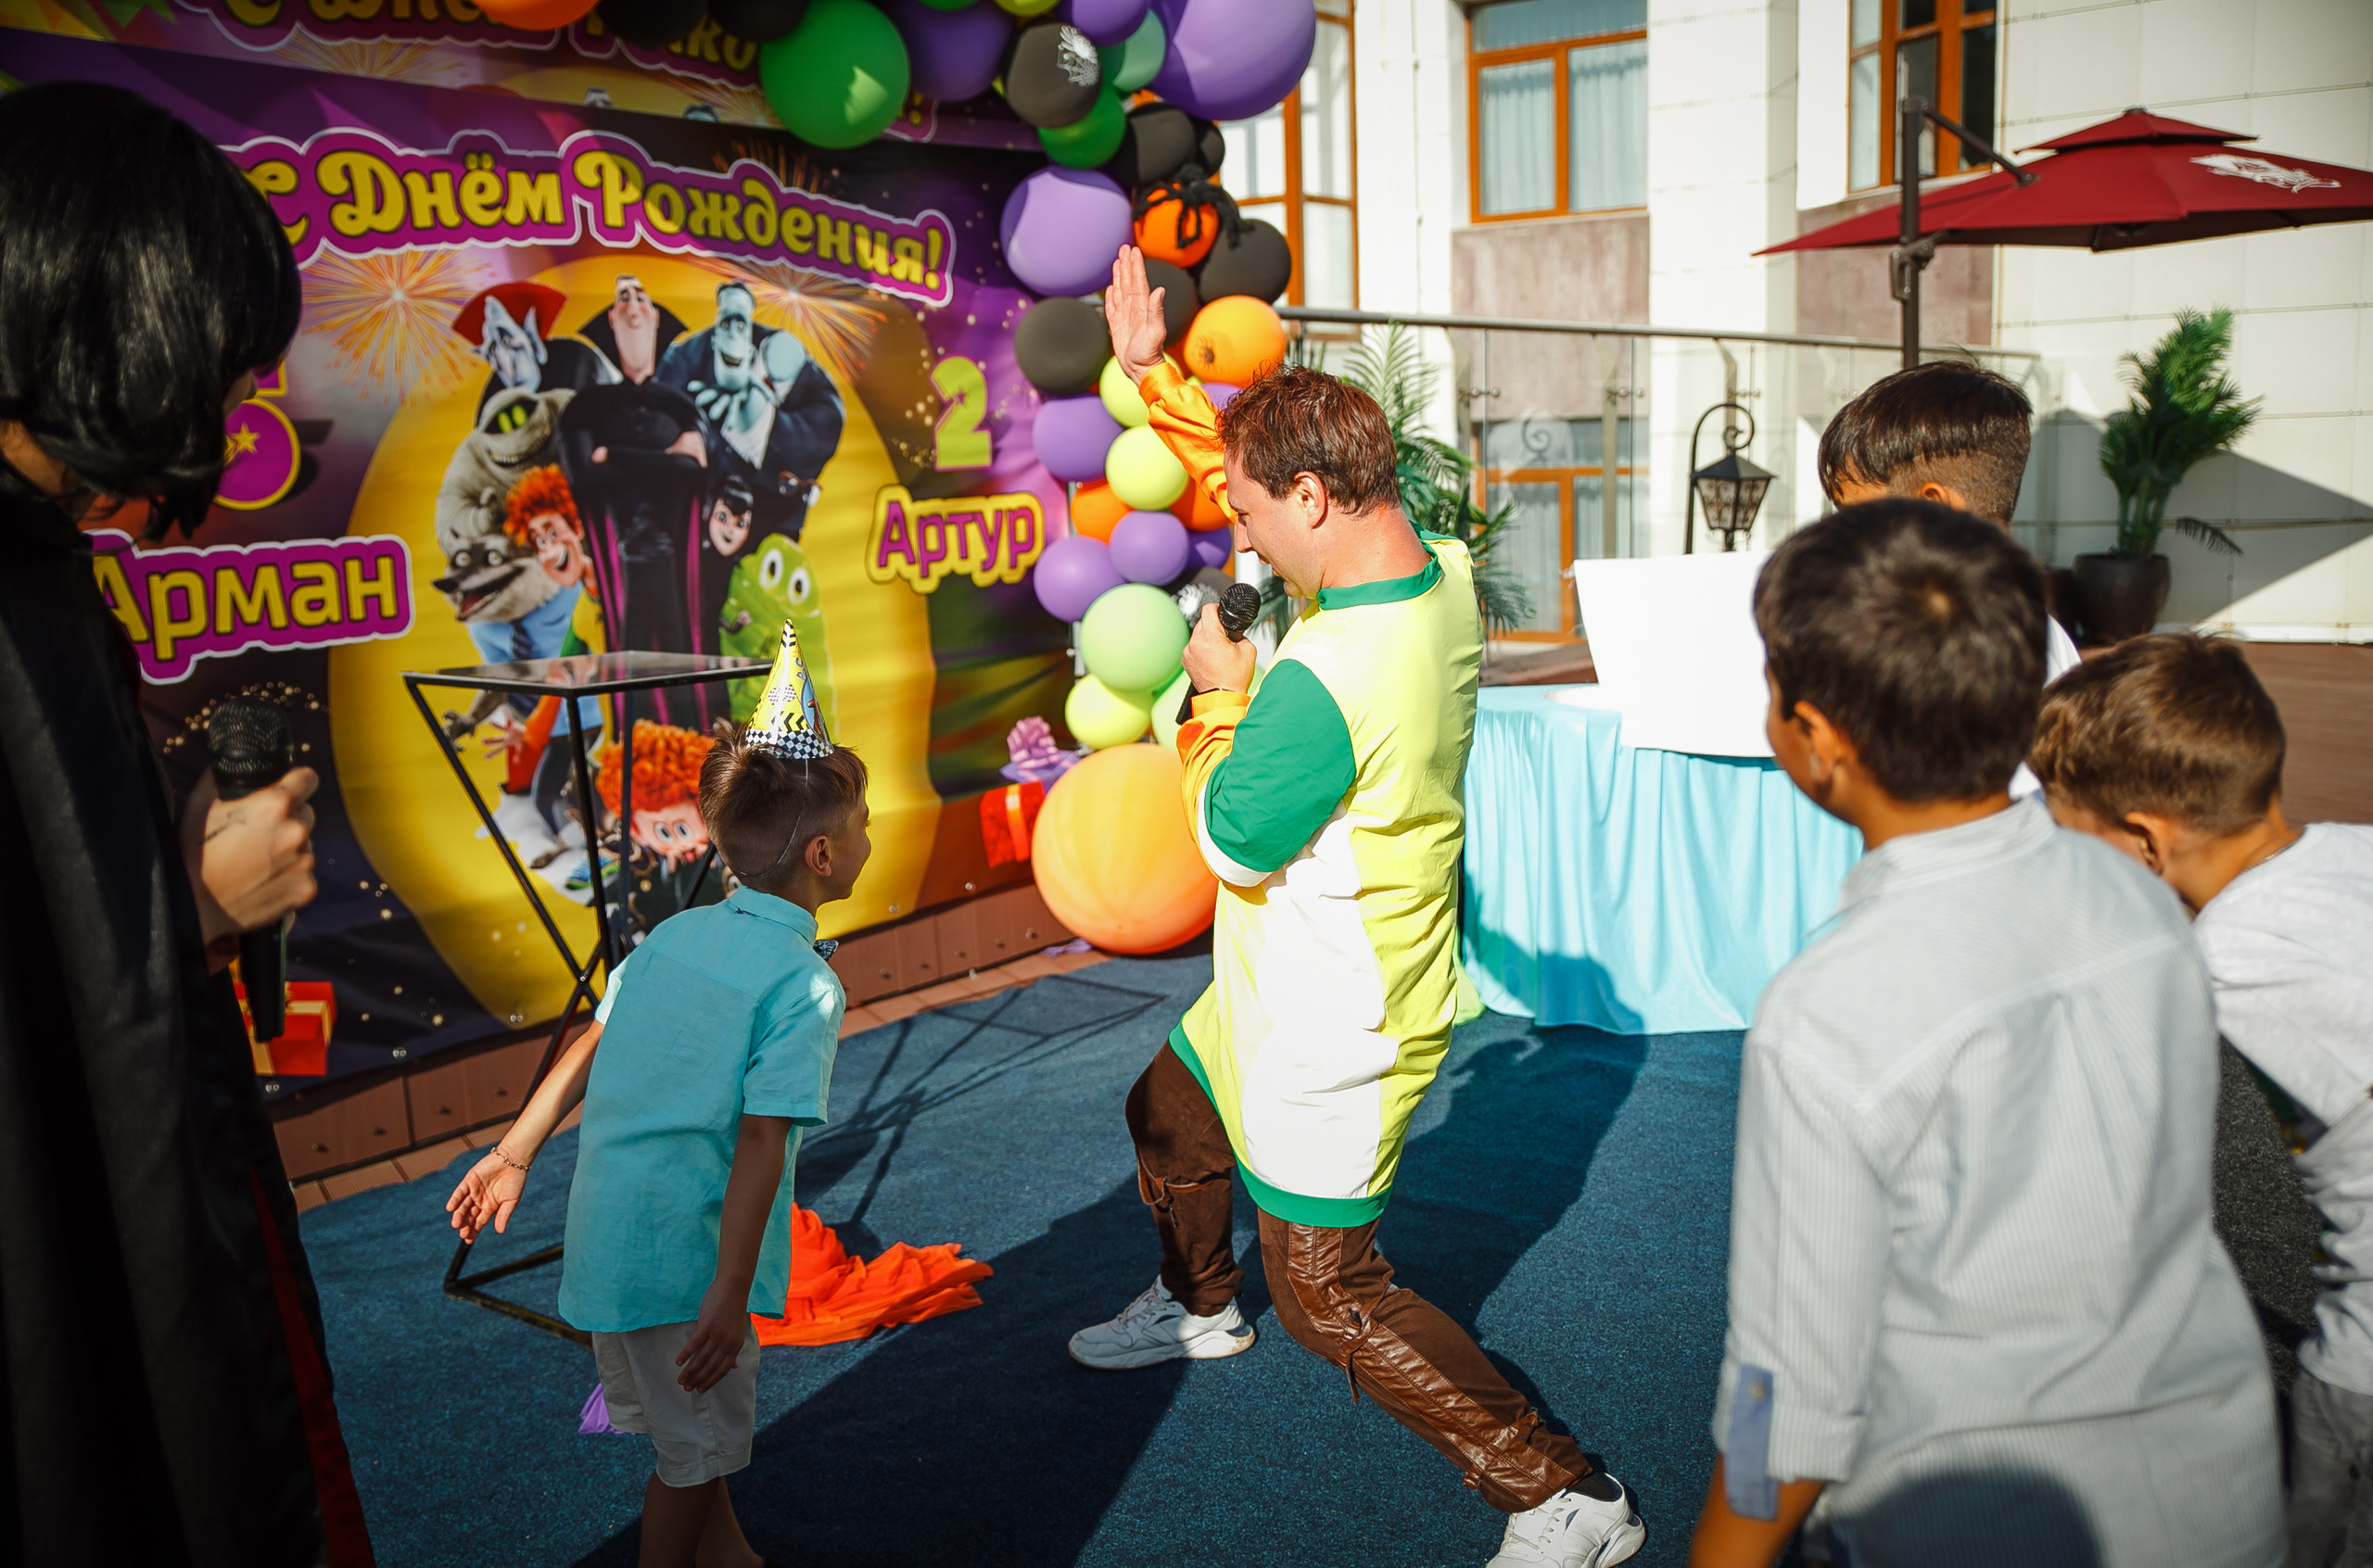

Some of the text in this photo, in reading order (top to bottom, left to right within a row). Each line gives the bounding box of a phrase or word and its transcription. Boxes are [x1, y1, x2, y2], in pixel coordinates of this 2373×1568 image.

[317, 151, 564, 237] Днём
[573, 150, 942, 291] Рождения!
[930, 356, 993, 469] 2
[878, 500, 1034, 577] Артур
[95, 556, 397, 661] Арман
